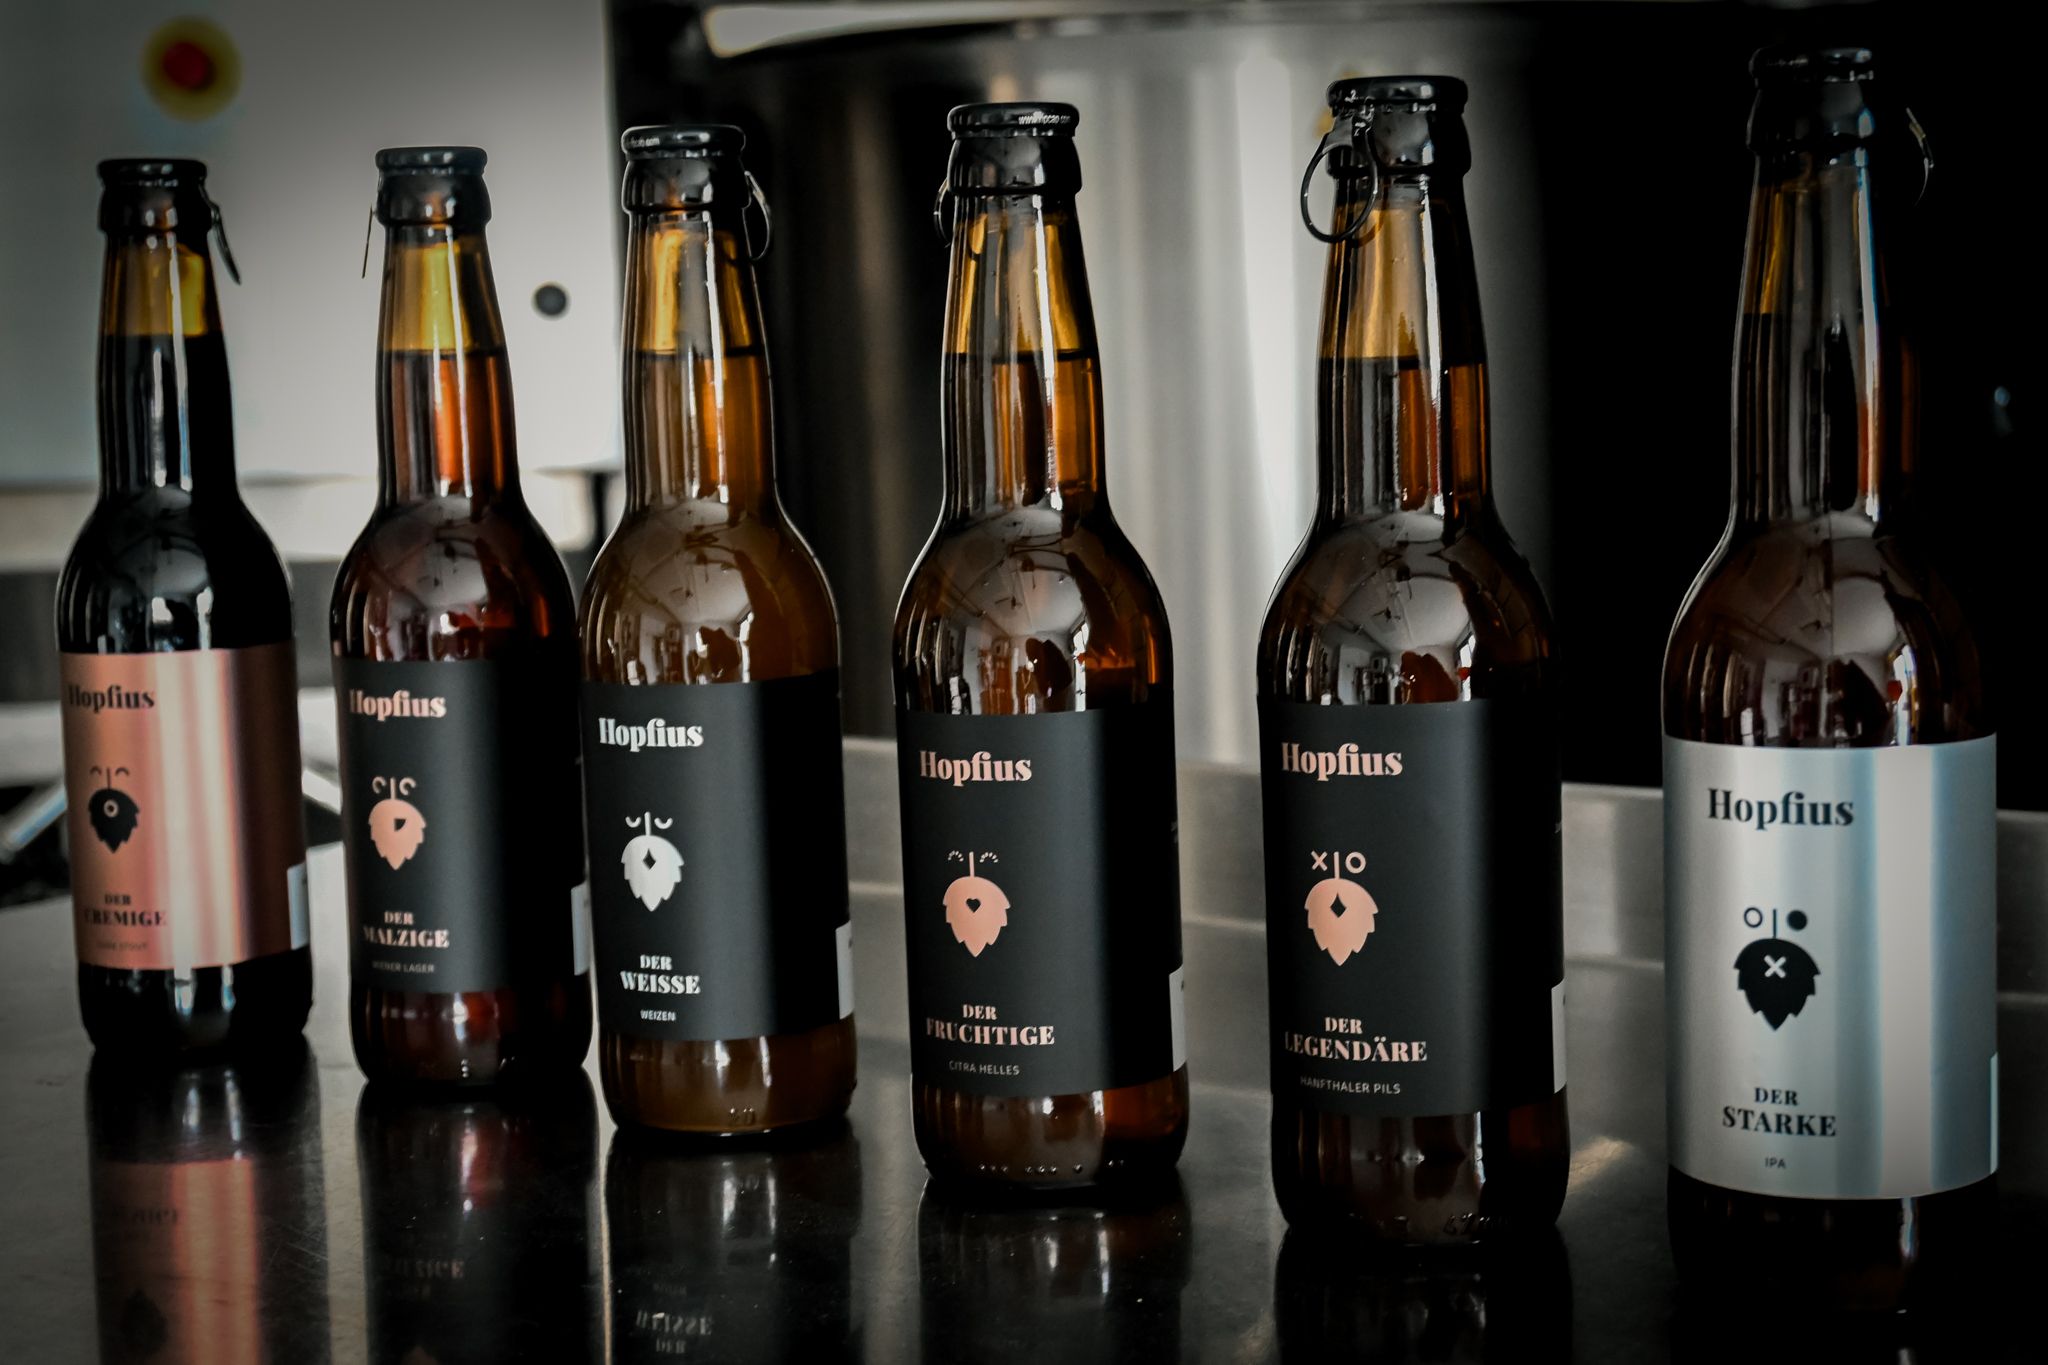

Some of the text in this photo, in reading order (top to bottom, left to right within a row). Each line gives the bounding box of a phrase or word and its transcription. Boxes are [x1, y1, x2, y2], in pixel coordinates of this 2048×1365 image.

[68, 684, 156, 713] Hopfius
[349, 689, 447, 722] Hopfius
[598, 717, 705, 752] Hopfius
[919, 750, 1032, 787] Hopfius
[1280, 741, 1404, 782] Hopfius
[1707, 788, 1855, 831] Hopfius
[104, 893, 132, 906] DER
[384, 910, 414, 925] DER
[403, 963, 435, 973] LAGER
[639, 954, 673, 971] DER
[620, 971, 701, 995] WEISSE
[640, 1009, 676, 1022] WEIZEN
[962, 1003, 997, 1021] DER
[926, 1018, 1055, 1046] FRUCHTIGE
[1324, 1016, 1363, 1035] DER
[1283, 1030, 1428, 1063] LEGENDÄRE
[948, 1060, 1020, 1076] CITRA HELLES
[1373, 1082, 1402, 1096] PILS
[1754, 1087, 1799, 1106] DER
[1722, 1106, 1837, 1137] STARKE
[1764, 1157, 1787, 1170] IPA
